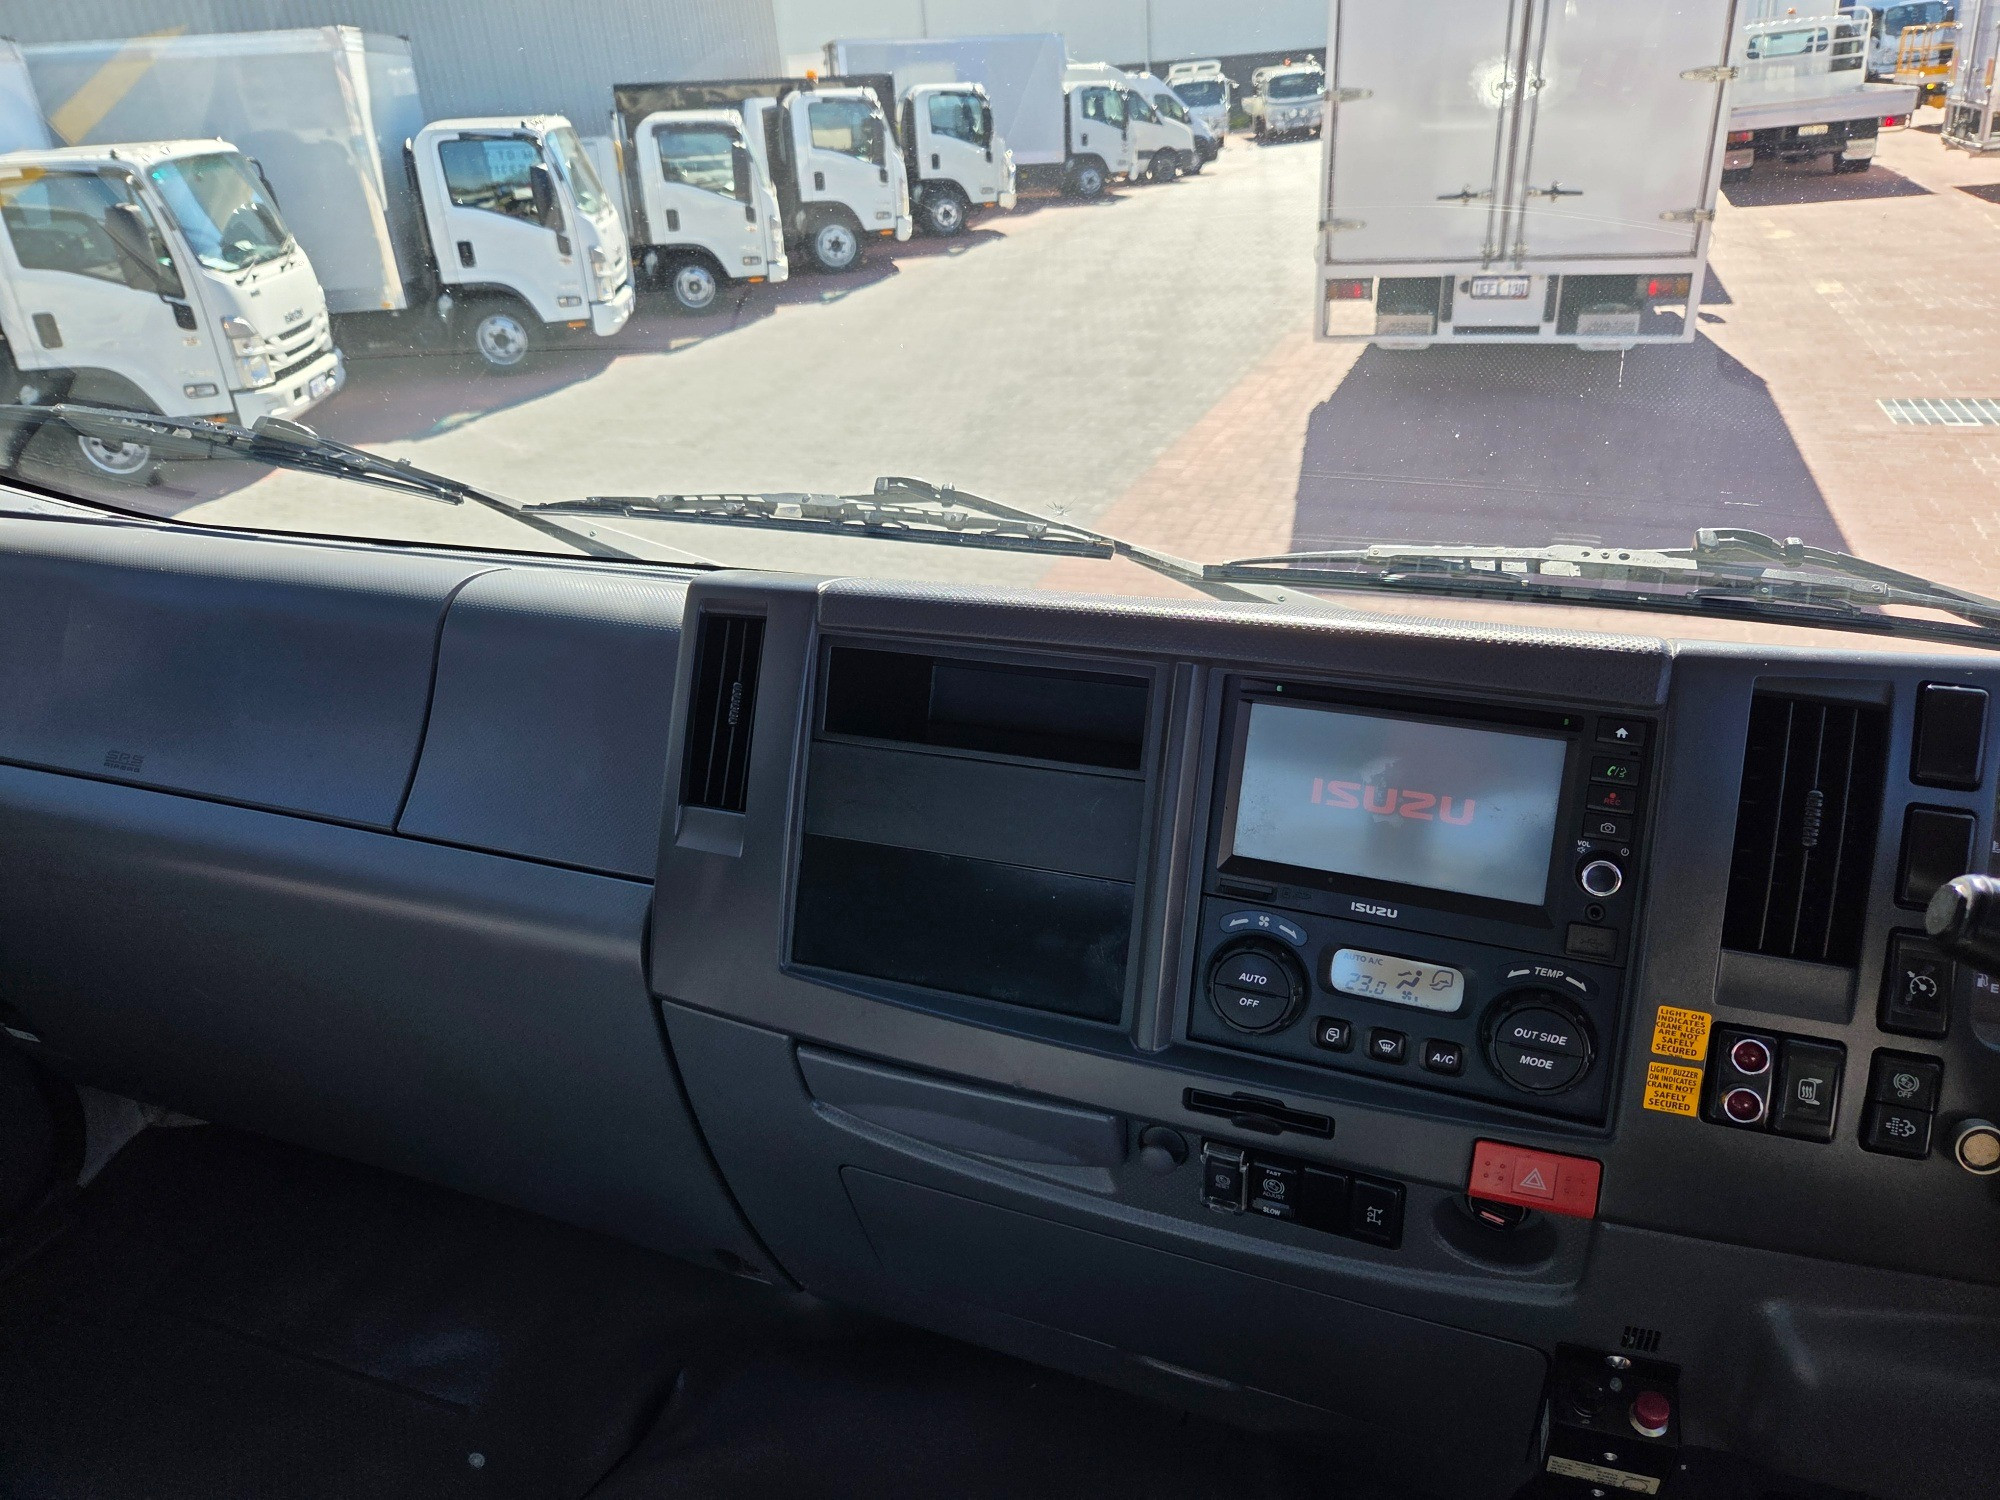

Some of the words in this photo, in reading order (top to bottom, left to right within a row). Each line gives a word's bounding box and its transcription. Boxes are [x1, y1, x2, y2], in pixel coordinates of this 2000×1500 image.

[1311, 777, 1476, 826] ISUZU
[1603, 797, 1621, 806] REC
[1577, 839, 1591, 848] VOL
[1350, 901, 1398, 919] ISUZU
[1343, 952, 1367, 963] AUTO
[1368, 958, 1384, 966] A/C
[1238, 972, 1268, 985] AUTO
[1534, 966, 1565, 979] TEMP
[1344, 972, 1387, 995] 23.0
[1990, 983, 2000, 994] E
[1239, 997, 1260, 1008] OFF
[1657, 1014, 1706, 1028] INDICATES
[1660, 1008, 1688, 1018] LIGHT
[1691, 1013, 1705, 1021] ON
[1656, 1021, 1683, 1031] CRANE
[1685, 1026, 1706, 1035] LEGS
[1658, 1028, 1677, 1037] ARE
[1680, 1031, 1700, 1041] NOT
[1514, 1027, 1538, 1040] OUT
[1539, 1032, 1568, 1046] SIDE
[1661, 1036, 1695, 1048] SAFELY
[1655, 1043, 1698, 1057] SECURED
[1432, 1053, 1454, 1064] A/C
[1519, 1054, 1554, 1070] MODE
[1648, 1073, 1660, 1081] ON
[1661, 1075, 1697, 1087] INDICATES
[1647, 1080, 1674, 1091] CRANE
[1675, 1085, 1695, 1094] NOT
[1653, 1090, 1687, 1102] SAFELY
[1897, 1090, 1913, 1099] OFF
[1647, 1097, 1691, 1112] SECURED
[1266, 1169, 1282, 1177] FAST
[1262, 1190, 1285, 1200] ADJUST
[1262, 1206, 1281, 1216] SLOW
